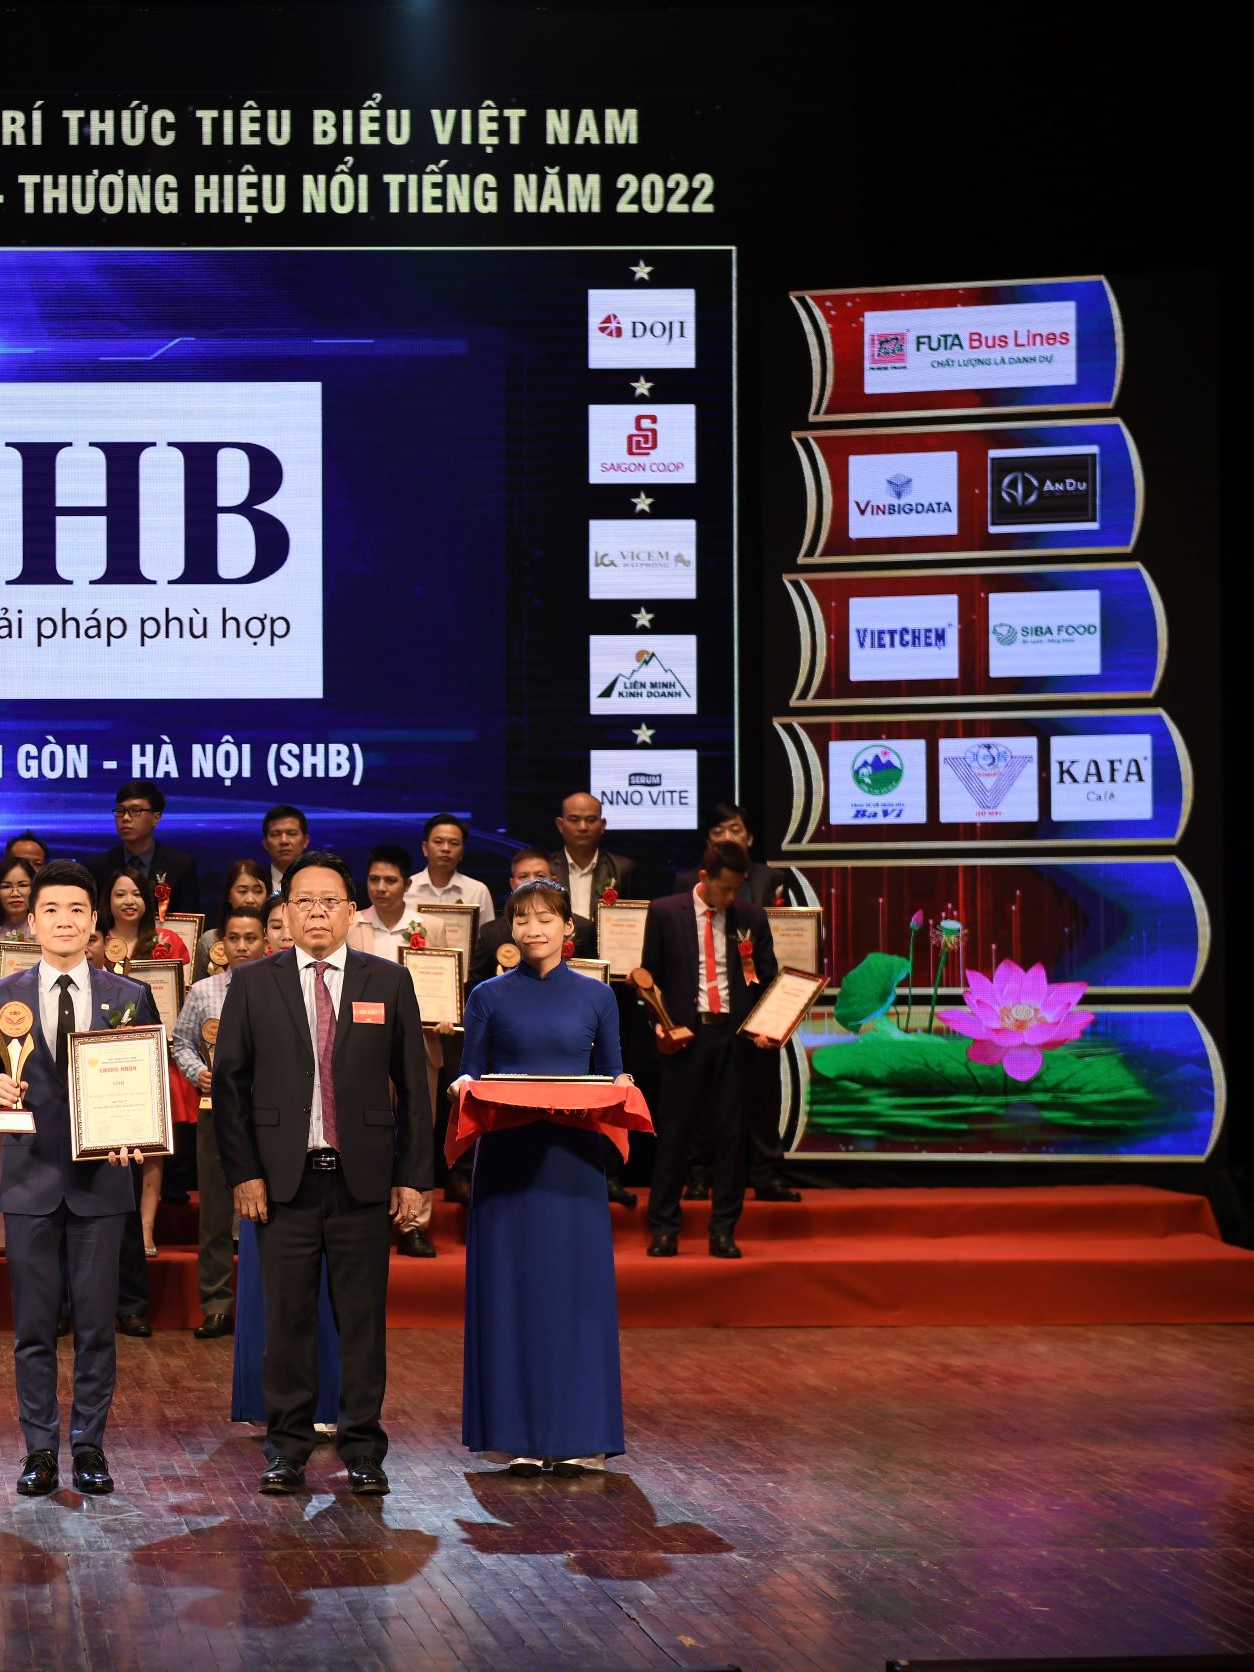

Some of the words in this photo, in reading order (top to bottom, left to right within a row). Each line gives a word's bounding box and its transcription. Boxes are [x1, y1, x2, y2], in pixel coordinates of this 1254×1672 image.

[62, 101, 175, 145] THỨC
[196, 101, 290, 145] TIÊU
[313, 94, 410, 145] BIỂU
[431, 101, 526, 153] VIỆT
[546, 109, 637, 144] NAM
[18, 170, 178, 214] THƯƠNG
[195, 165, 285, 222] HIỆU
[303, 157, 368, 213] NỔI
[383, 160, 497, 213] TIẾNG
[514, 167, 600, 212] NĂM
[617, 173, 713, 213] 2022
[631, 320, 687, 345] DOJI
[915, 333, 964, 352] FUTA
[968, 332, 1009, 350] Bus
[1014, 329, 1070, 348] Lines
[1008, 356, 1037, 366] DANH
[600, 461, 646, 473] SAIGON
[620, 551, 669, 561] VICEM
[36, 607, 128, 648] pháp
[140, 607, 207, 647] phù
[222, 607, 291, 647] hợp
[1021, 625, 1053, 637] SIBA
[1057, 624, 1097, 636] FOOD
[623, 680, 646, 689] LIÊN
[649, 681, 676, 689] MINH
[646, 690, 681, 698] DOANH
[18, 736, 87, 779] GÒN
[103, 761, 117, 769] -
[132, 736, 179, 779] HÀ
[193, 735, 251, 786] NỘI
[268, 743, 363, 785] (SHB)
[1056, 757, 1145, 784] KAFA
[630, 775, 661, 785] SERUM
[648, 790, 689, 806] VITE
[1087, 789, 1115, 801] Café
